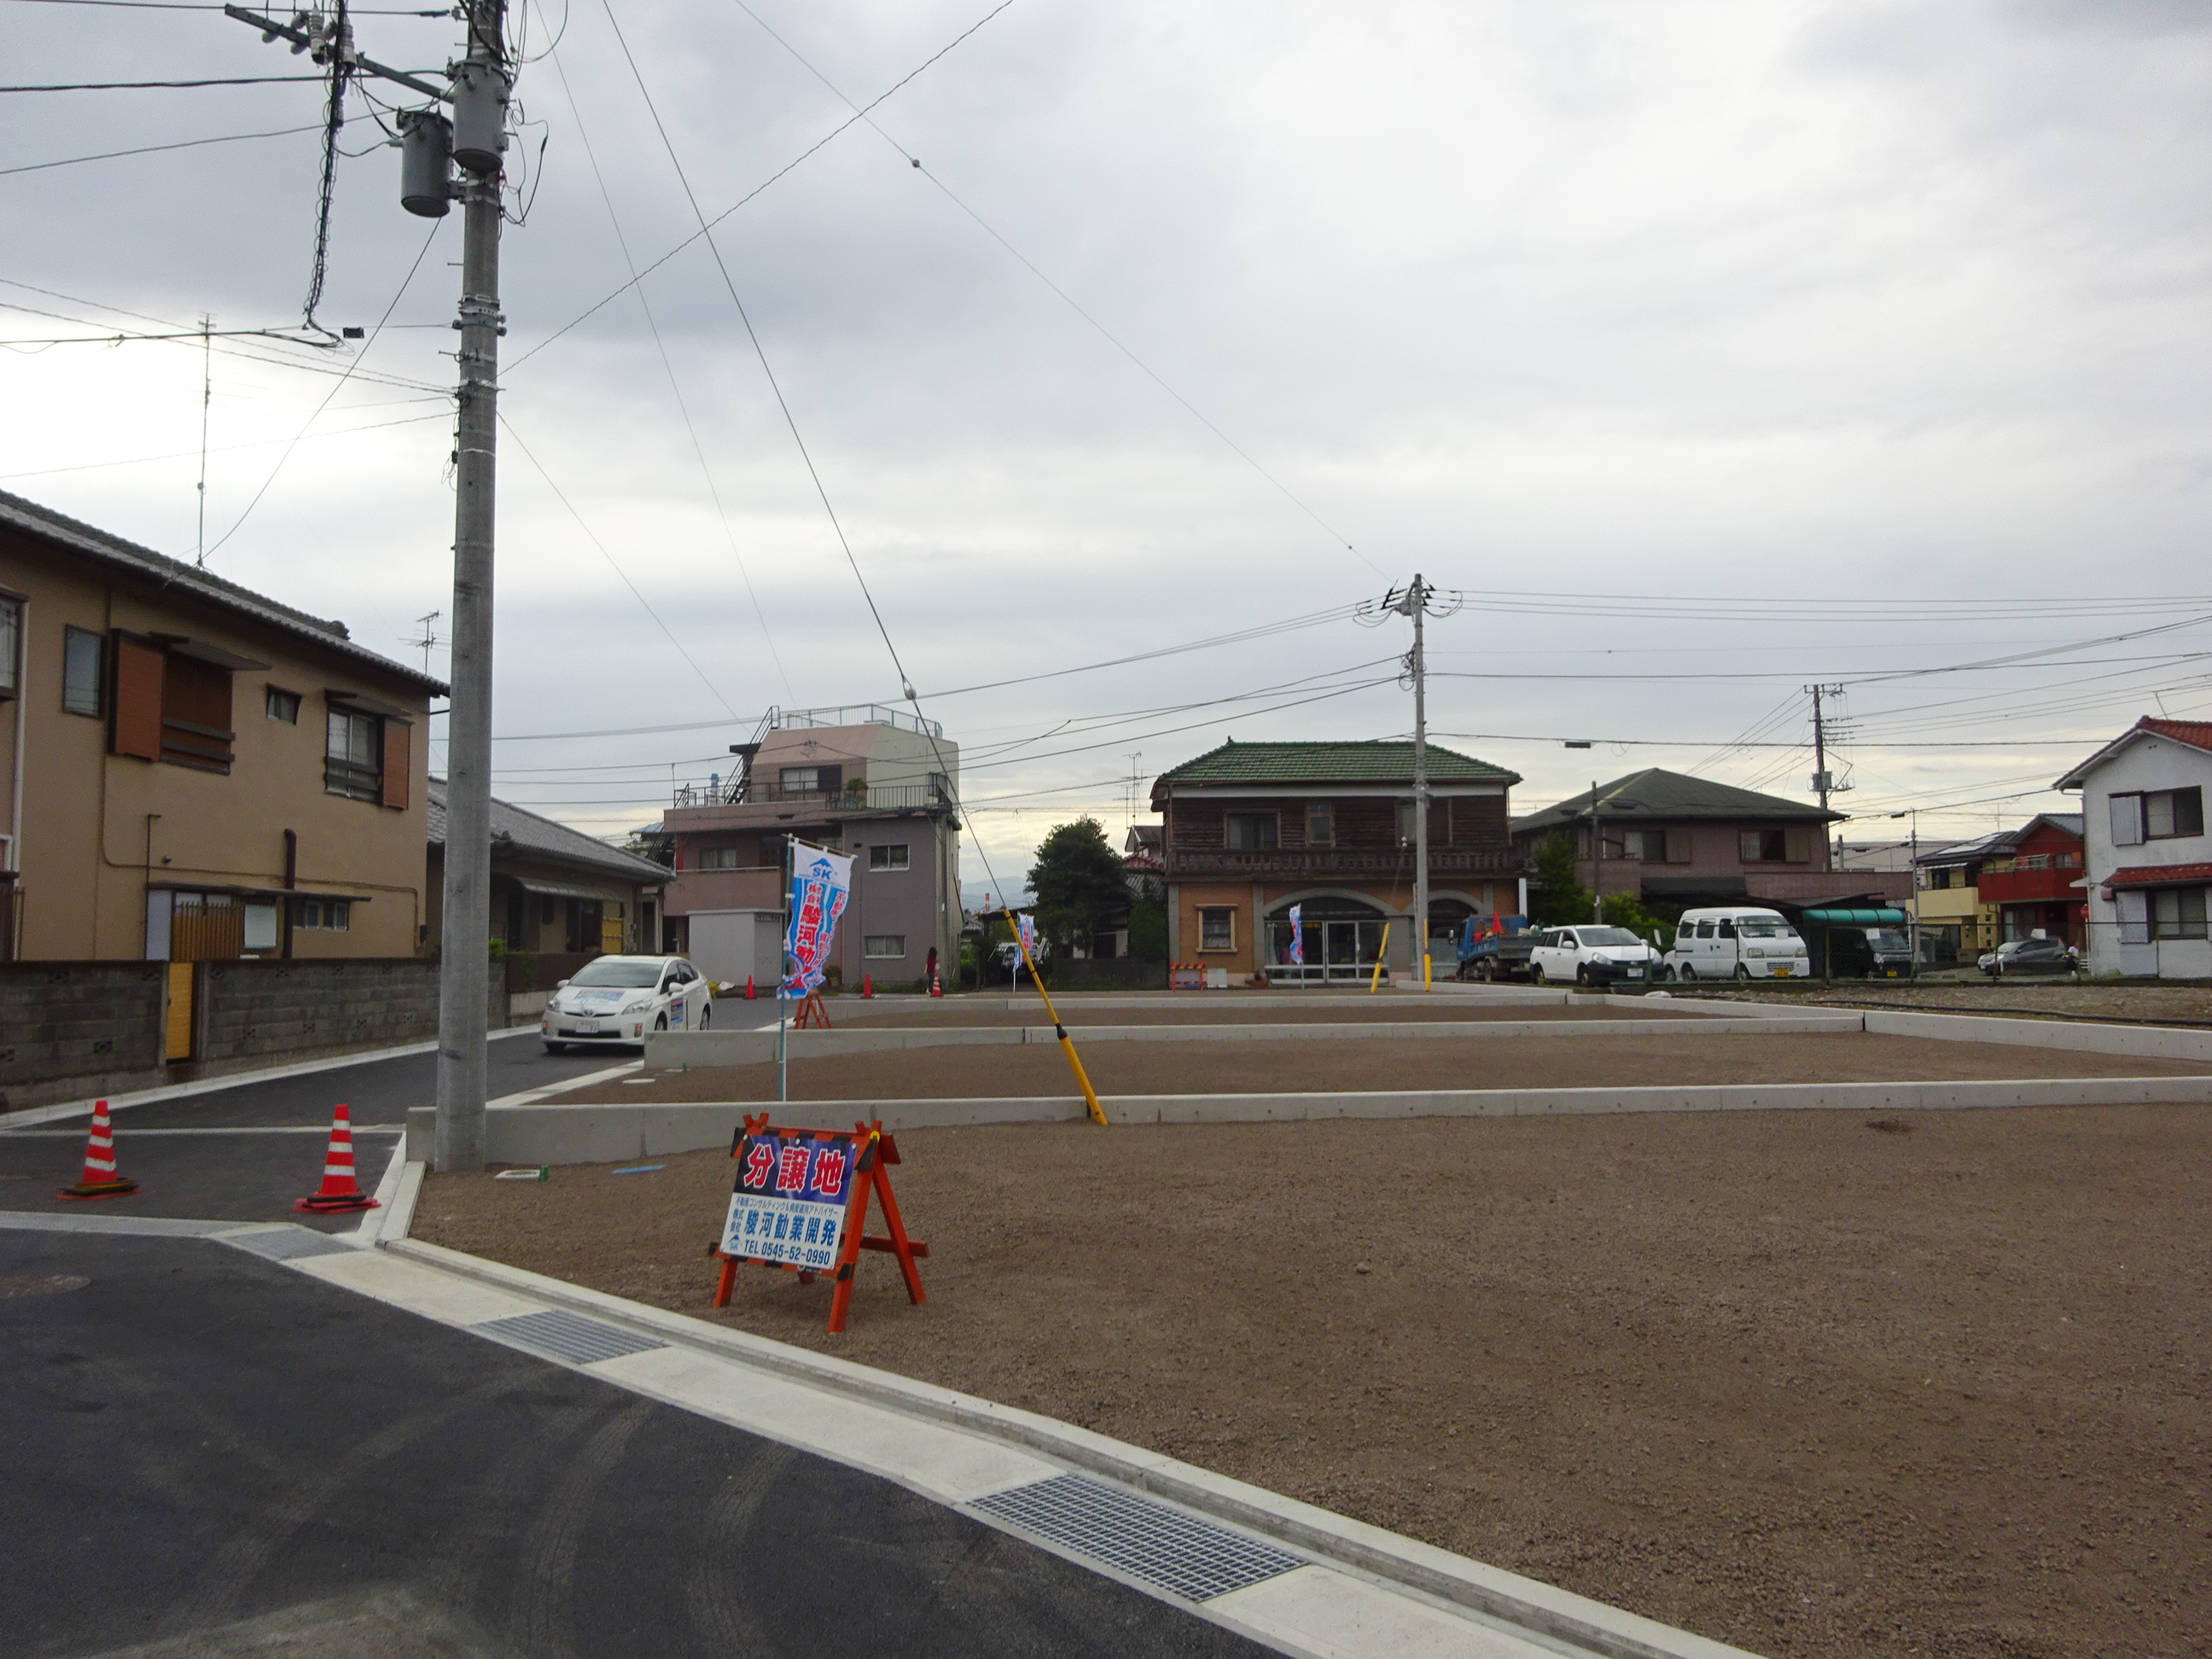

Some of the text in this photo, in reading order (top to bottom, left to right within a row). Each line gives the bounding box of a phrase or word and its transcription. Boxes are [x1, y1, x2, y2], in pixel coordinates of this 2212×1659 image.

[813, 867, 832, 880] SK
[744, 1143, 846, 1196] 分譲地
[744, 1209, 836, 1246] 駿河勧業開発
[744, 1239, 830, 1265] TEL 0545-52-0990
